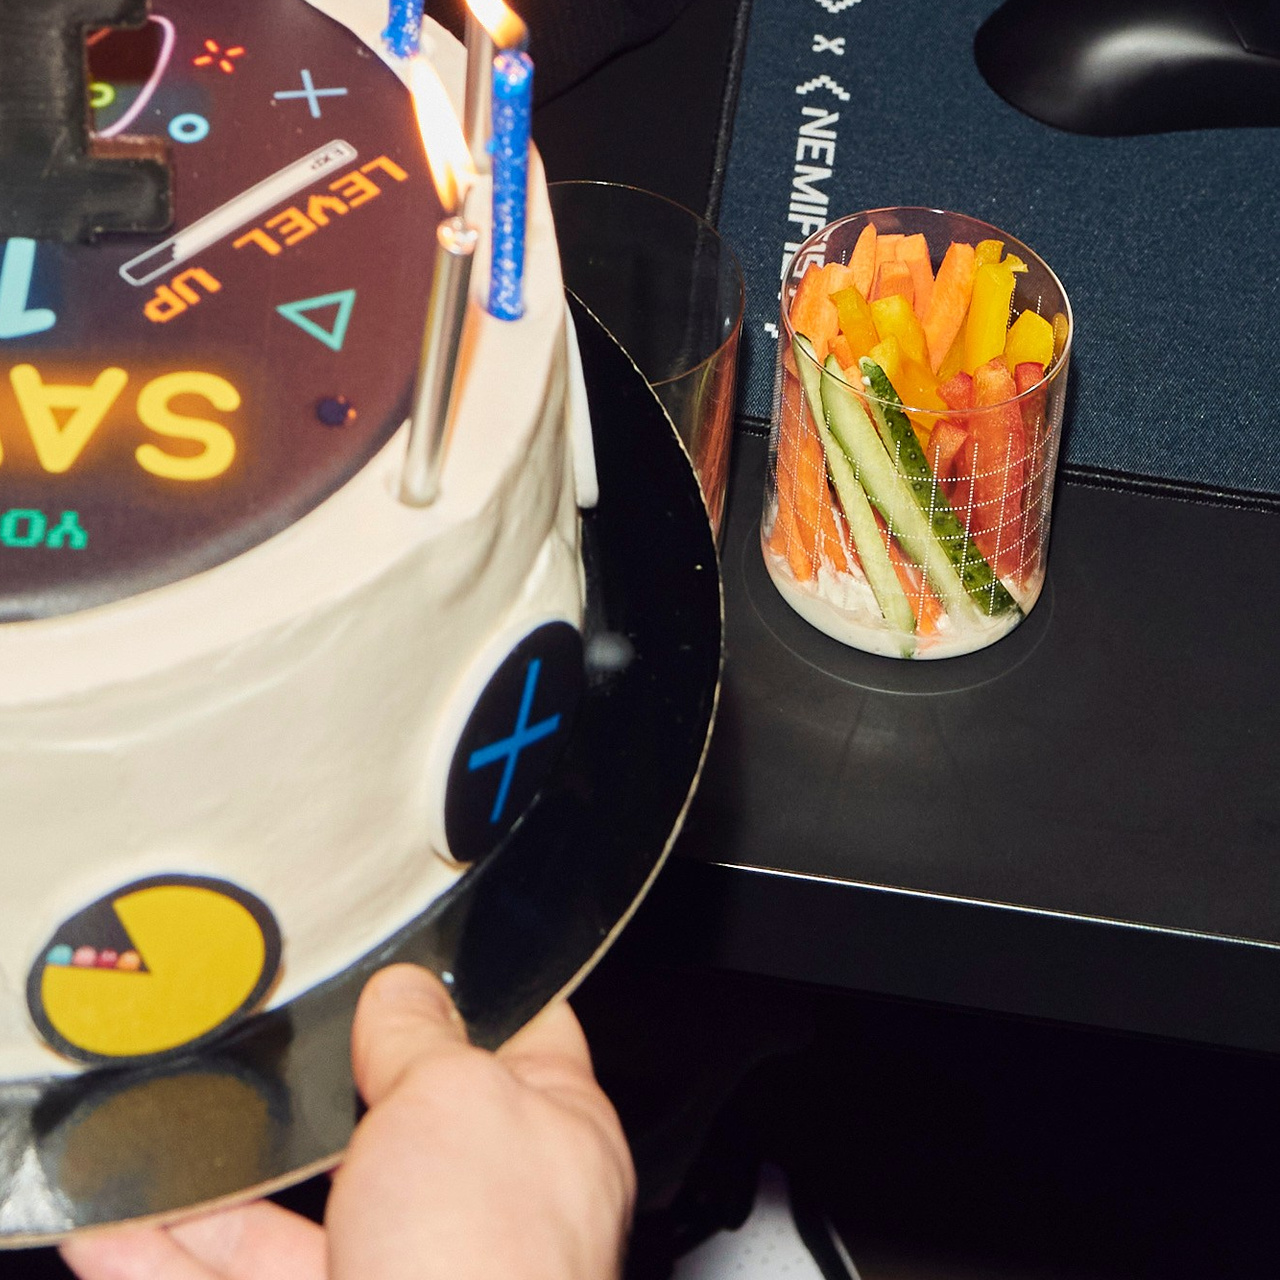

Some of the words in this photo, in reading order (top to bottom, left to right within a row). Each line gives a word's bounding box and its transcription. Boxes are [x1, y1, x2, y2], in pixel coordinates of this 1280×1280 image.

[232, 154, 410, 257] LEVEL
[778, 106, 840, 300] NEMIFIS
[143, 267, 222, 324] UP
